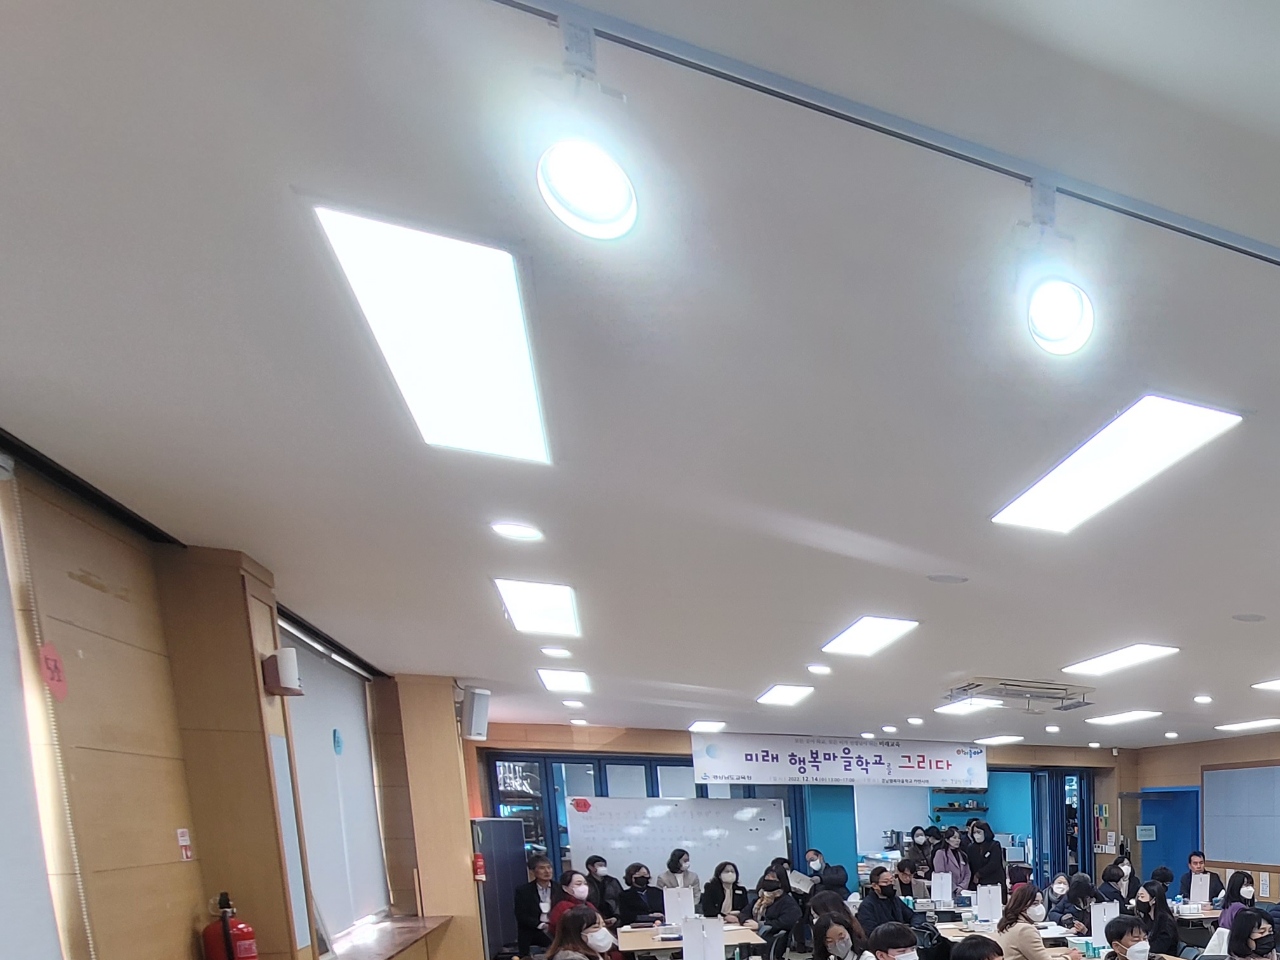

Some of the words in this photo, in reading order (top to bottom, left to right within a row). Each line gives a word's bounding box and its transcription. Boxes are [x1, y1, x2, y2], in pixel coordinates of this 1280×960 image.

[744, 750, 779, 763] 미래
[788, 747, 893, 775] 행복마을학교를
[898, 754, 952, 770] 그리다
